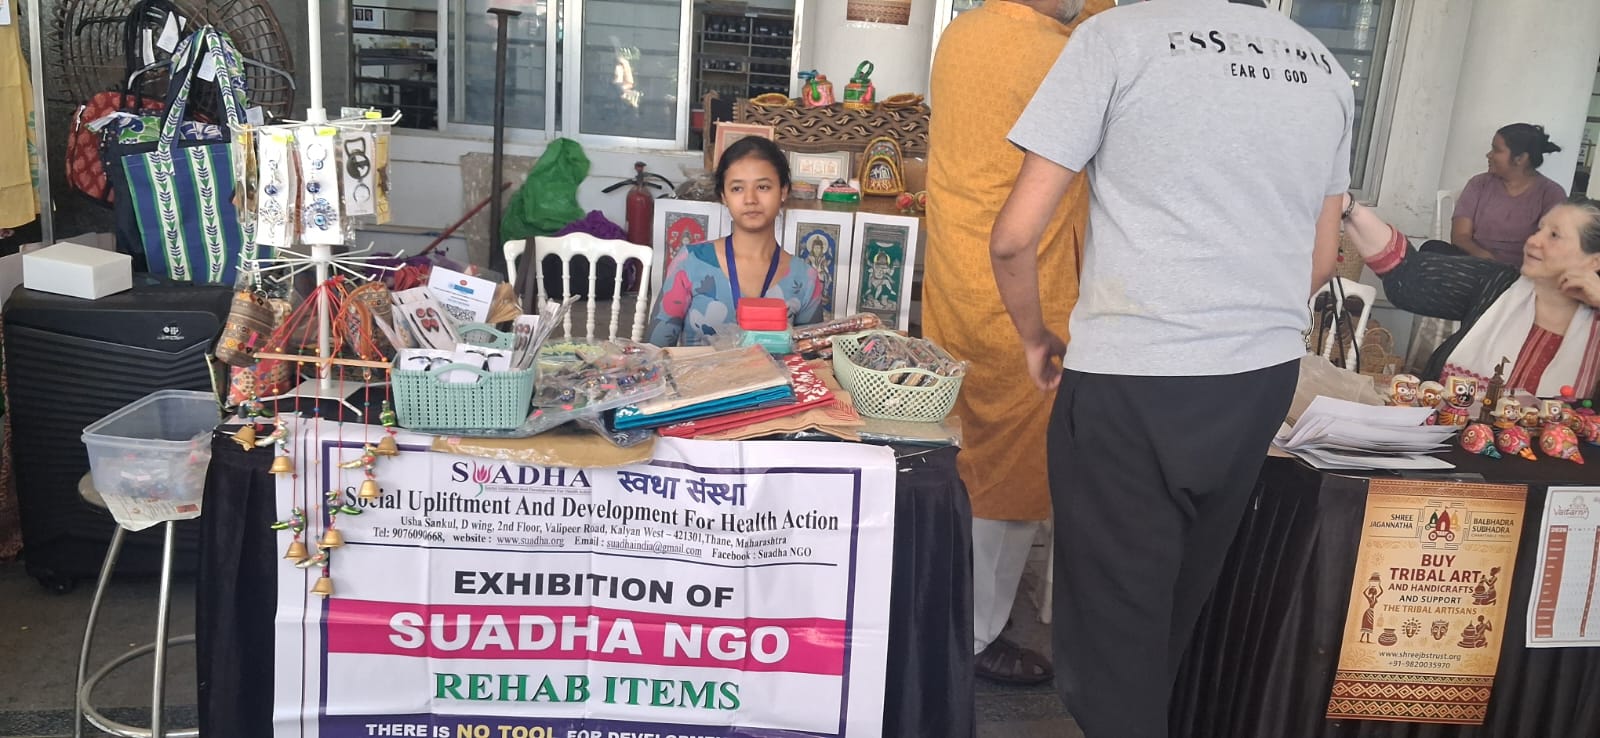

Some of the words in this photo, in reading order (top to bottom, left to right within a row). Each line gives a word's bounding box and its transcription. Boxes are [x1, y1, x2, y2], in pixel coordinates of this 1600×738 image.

[1284, 69, 1308, 84] GOD
[452, 460, 592, 488] SUADHA
[617, 470, 680, 500] स्वधा
[685, 477, 747, 506] संस्था
[408, 490, 511, 517] Upliftment
[516, 495, 556, 516] And
[562, 497, 678, 525] Development
[685, 509, 716, 530] For
[722, 511, 777, 533] Health
[782, 508, 839, 531] Action
[1390, 514, 1414, 522] SHREE
[1369, 521, 1413, 529] JAGANNATHA
[1472, 525, 1510, 534] SUBHADRA
[1473, 518, 1514, 526] BALBHADRA
[401, 516, 423, 527] Usha
[424, 518, 459, 530] Sankul,
[461, 519, 469, 530] D
[471, 520, 495, 533] wing,
[497, 521, 514, 532] 2nd
[517, 522, 543, 534] Floor,
[545, 522, 580, 535] Valipeer
[583, 523, 608, 535] Road,
[610, 525, 641, 538] Kalyan
[643, 527, 664, 538] West
[735, 536, 787, 549] Maharashtra
[373, 527, 390, 538] Tel:
[392, 528, 446, 543] 9076090668,
[453, 534, 486, 543] website
[497, 536, 565, 548] www.suadha.org
[574, 536, 599, 546] Email
[711, 548, 751, 561] Facebook
[758, 548, 788, 559] Suadha
[790, 547, 813, 557] NGO
[1421, 554, 1456, 567] BUY
[1390, 568, 1446, 582] TRIBAL
[1450, 570, 1482, 583] ART
[454, 570, 674, 604] EXHIBITION
[686, 584, 734, 608] OF
[1388, 583, 1409, 591] AND
[1410, 584, 1474, 593] HANDICRAFTS
[1420, 596, 1462, 604] SUPPORT
[1383, 604, 1400, 612] THE
[1402, 605, 1432, 613] TRIBAL
[1435, 607, 1477, 615] ARTISANS
[388, 612, 643, 656] SUADHA
[662, 621, 791, 665] NGO
[1378, 650, 1462, 661] www.shreejbstrust.org
[433, 672, 591, 703] REHAB
[603, 676, 742, 711] ITEMS
[366, 723, 428, 737] THERE
[432, 725, 451, 738] IS
[456, 724, 491, 738] NO
[497, 725, 555, 738] TOOL
